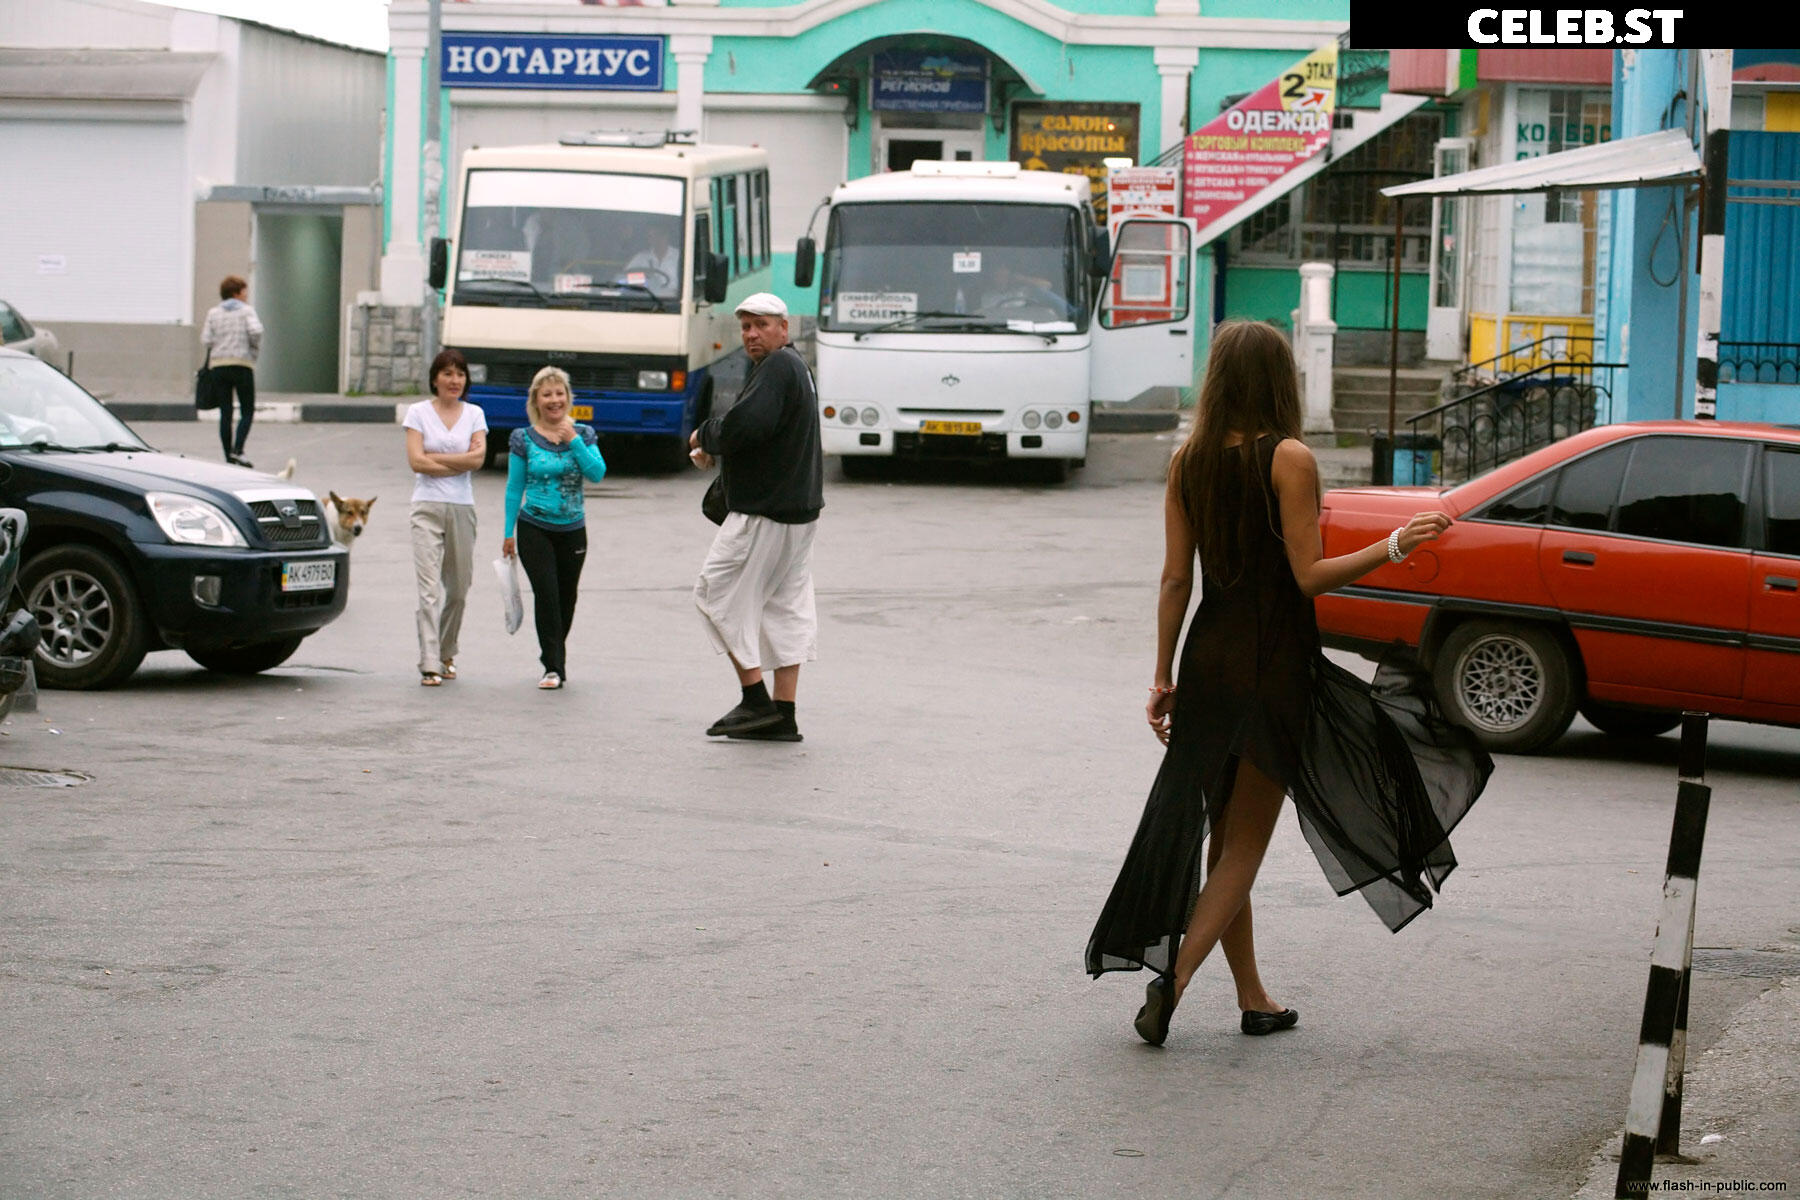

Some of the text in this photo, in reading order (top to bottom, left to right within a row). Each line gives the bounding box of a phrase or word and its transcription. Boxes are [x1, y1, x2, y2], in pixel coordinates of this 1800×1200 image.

[447, 46, 650, 76] НОТАРИУС
[1283, 62, 1334, 98] 2 ЭТАЖ
[1227, 109, 1330, 135] ОДЕЖДА
[288, 565, 301, 582] AK
